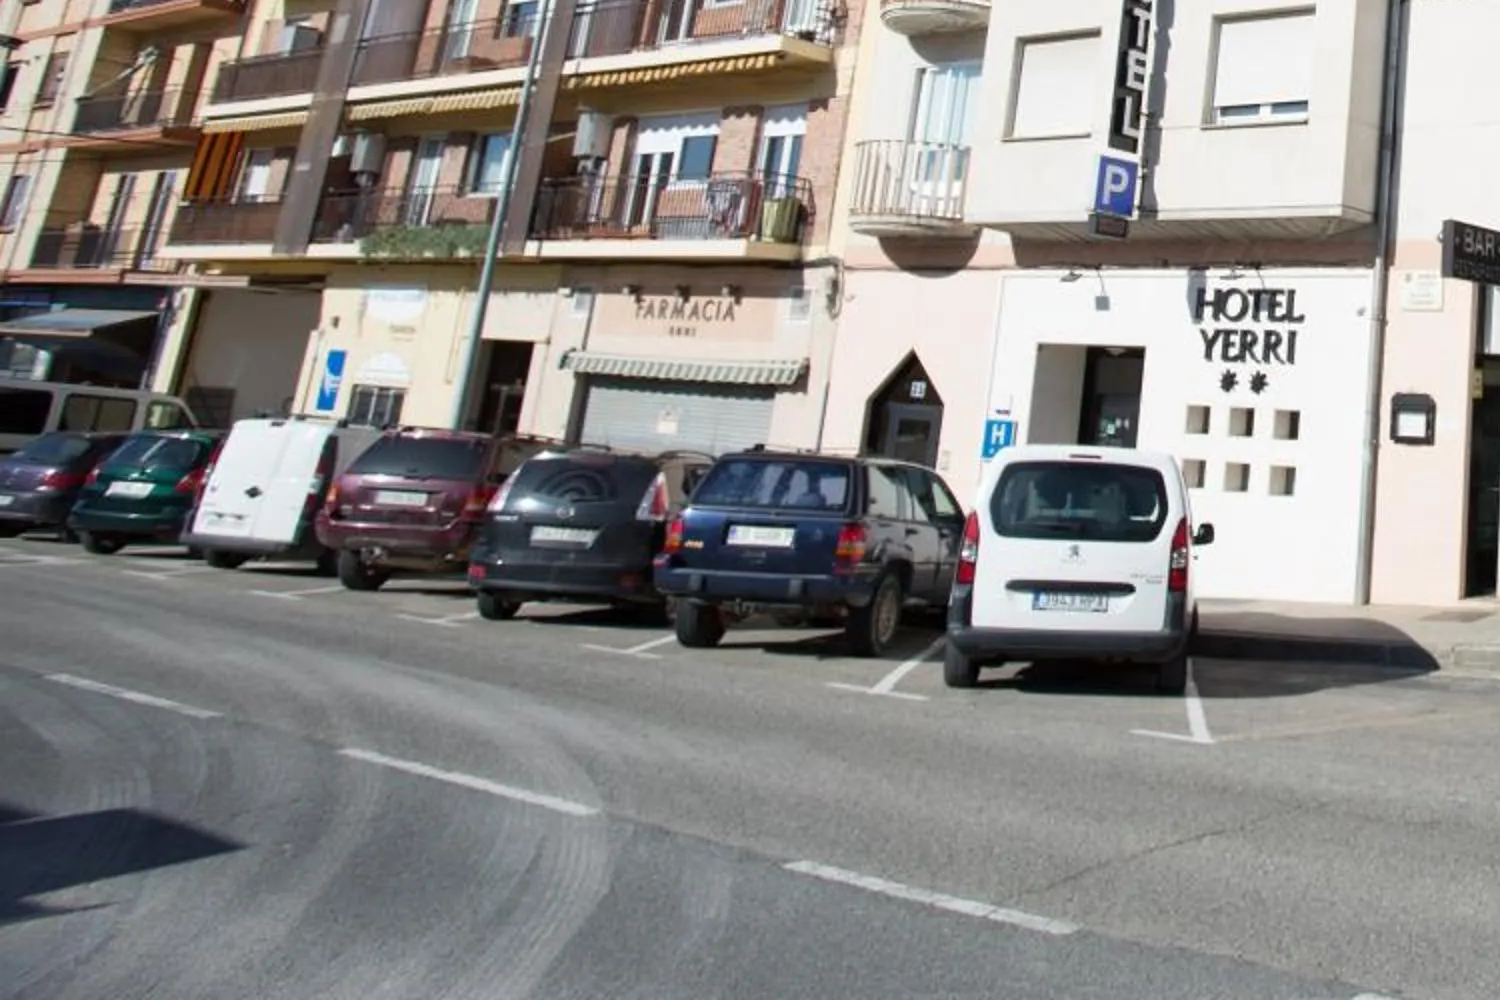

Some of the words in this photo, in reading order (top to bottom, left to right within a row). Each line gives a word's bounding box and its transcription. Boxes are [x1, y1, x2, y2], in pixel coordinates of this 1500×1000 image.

[1101, 164, 1129, 205] P
[1462, 227, 1496, 259] BAR
[635, 298, 736, 322] FARMACIA
[1195, 287, 1305, 323] HOTEL
[1200, 328, 1298, 365] YERRI
[991, 423, 1007, 446] H
